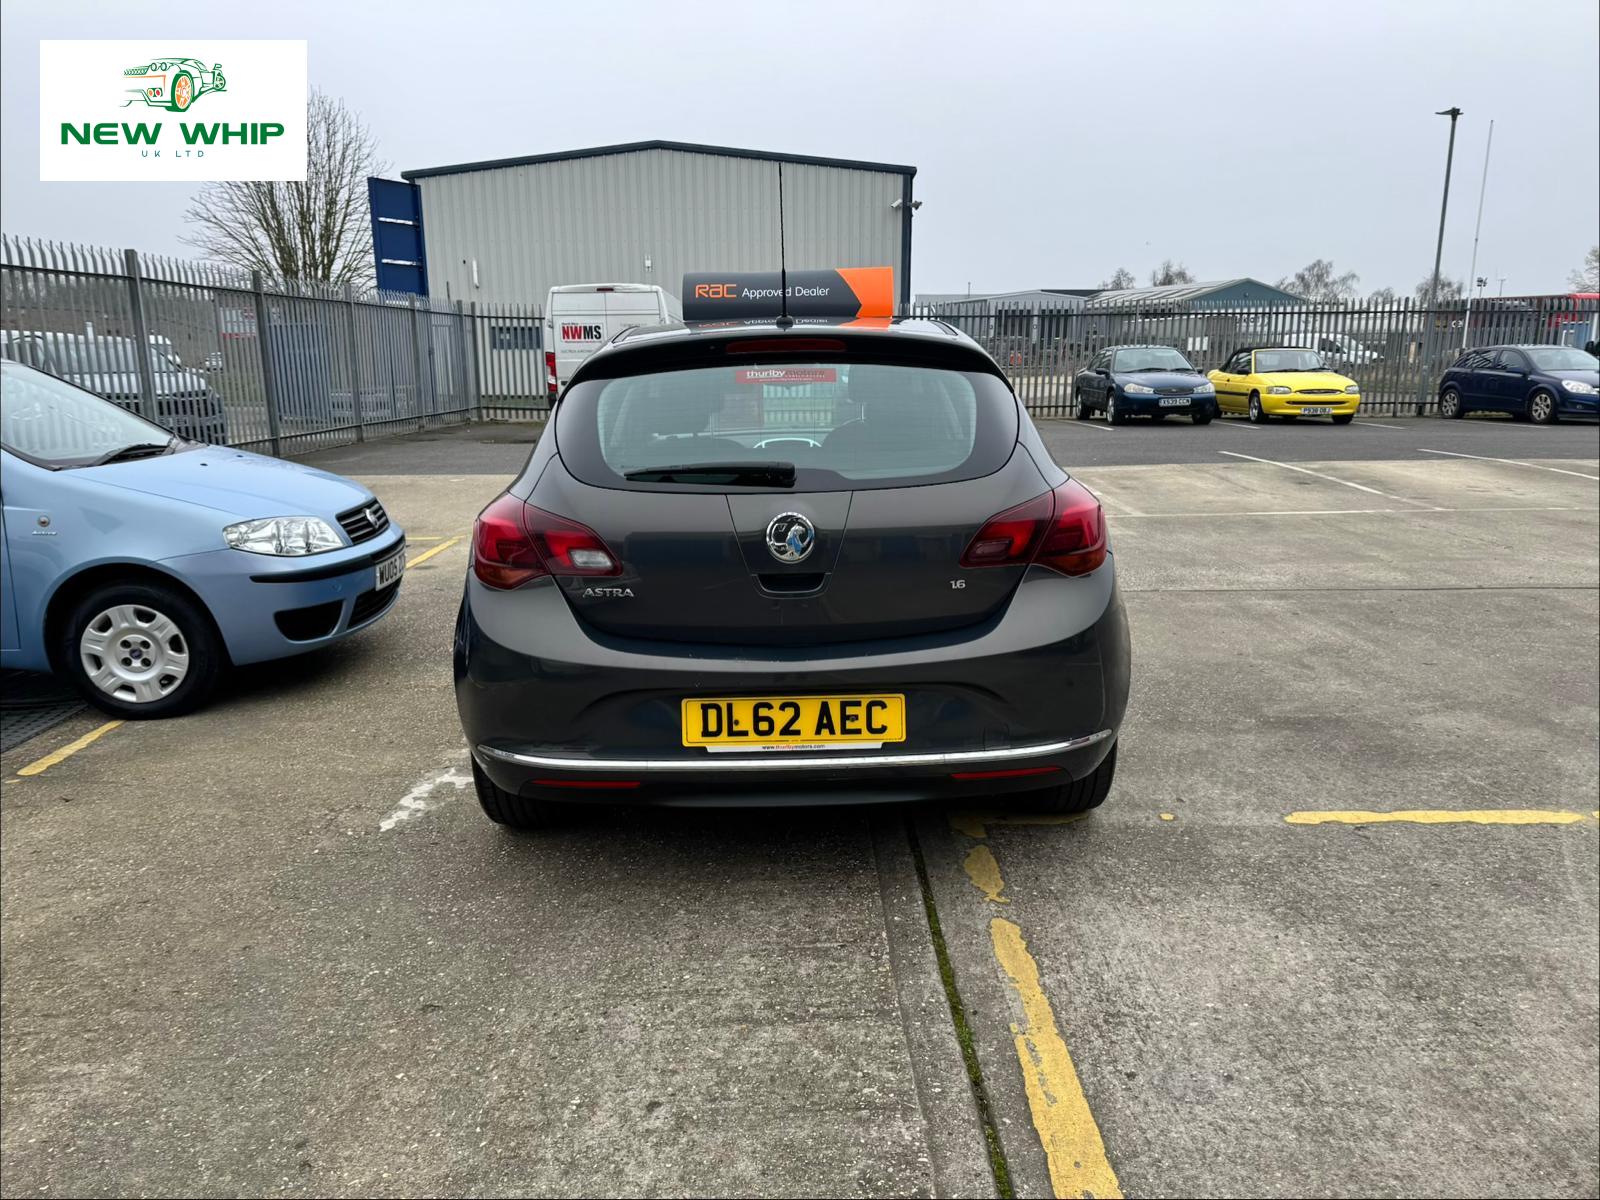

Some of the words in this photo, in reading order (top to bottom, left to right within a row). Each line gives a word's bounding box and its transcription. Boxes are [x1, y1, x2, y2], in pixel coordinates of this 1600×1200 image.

[741, 286, 791, 300] Approved
[795, 286, 830, 297] Dealer
[562, 326, 602, 340] NWMS
[582, 587, 635, 598] ASTRA
[700, 701, 801, 738] DL62
[814, 700, 888, 736] AEC
